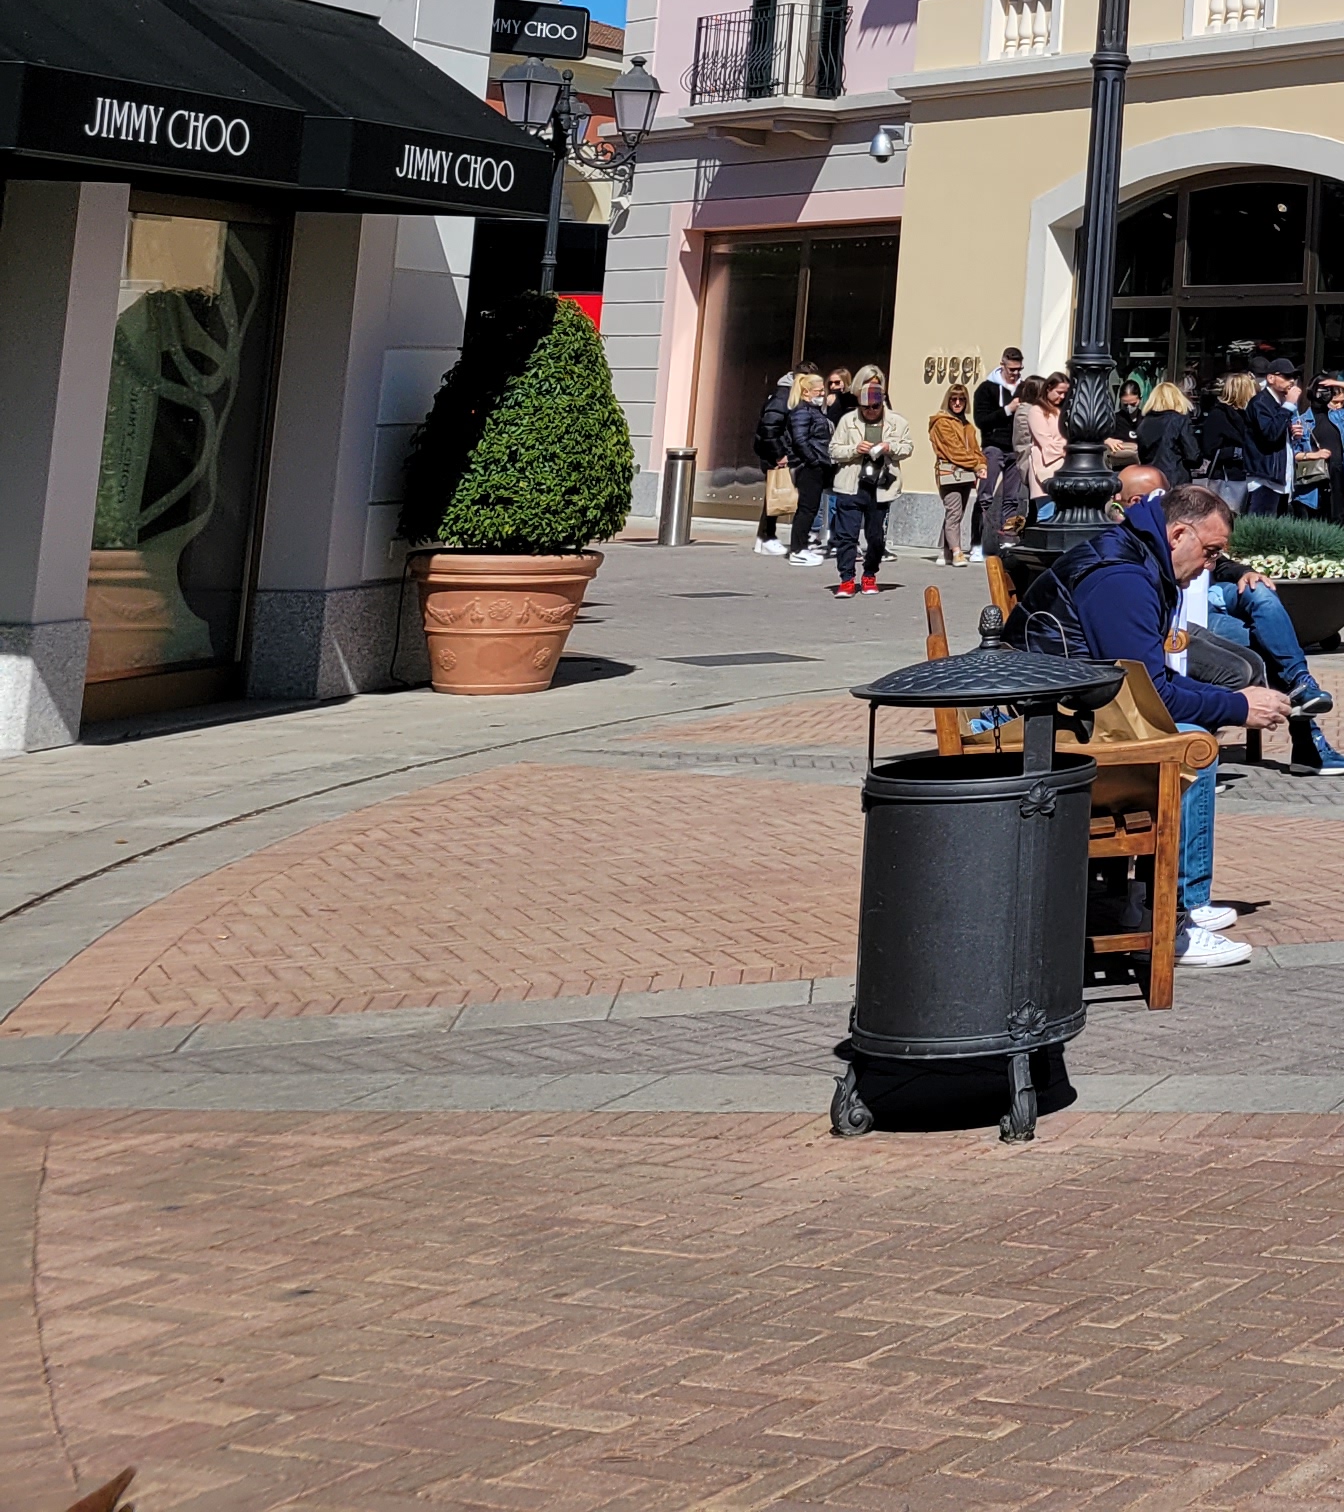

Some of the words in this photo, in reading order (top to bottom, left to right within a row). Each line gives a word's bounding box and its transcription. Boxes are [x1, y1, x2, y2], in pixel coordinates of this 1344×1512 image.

[492, 18, 521, 35] MMY
[524, 21, 577, 40] CHOO
[85, 97, 165, 144] JIMMY
[168, 110, 250, 156] CHOO
[395, 144, 453, 184] JIMMY
[455, 154, 515, 192] CHOO
[924, 356, 981, 379] GUCCI
